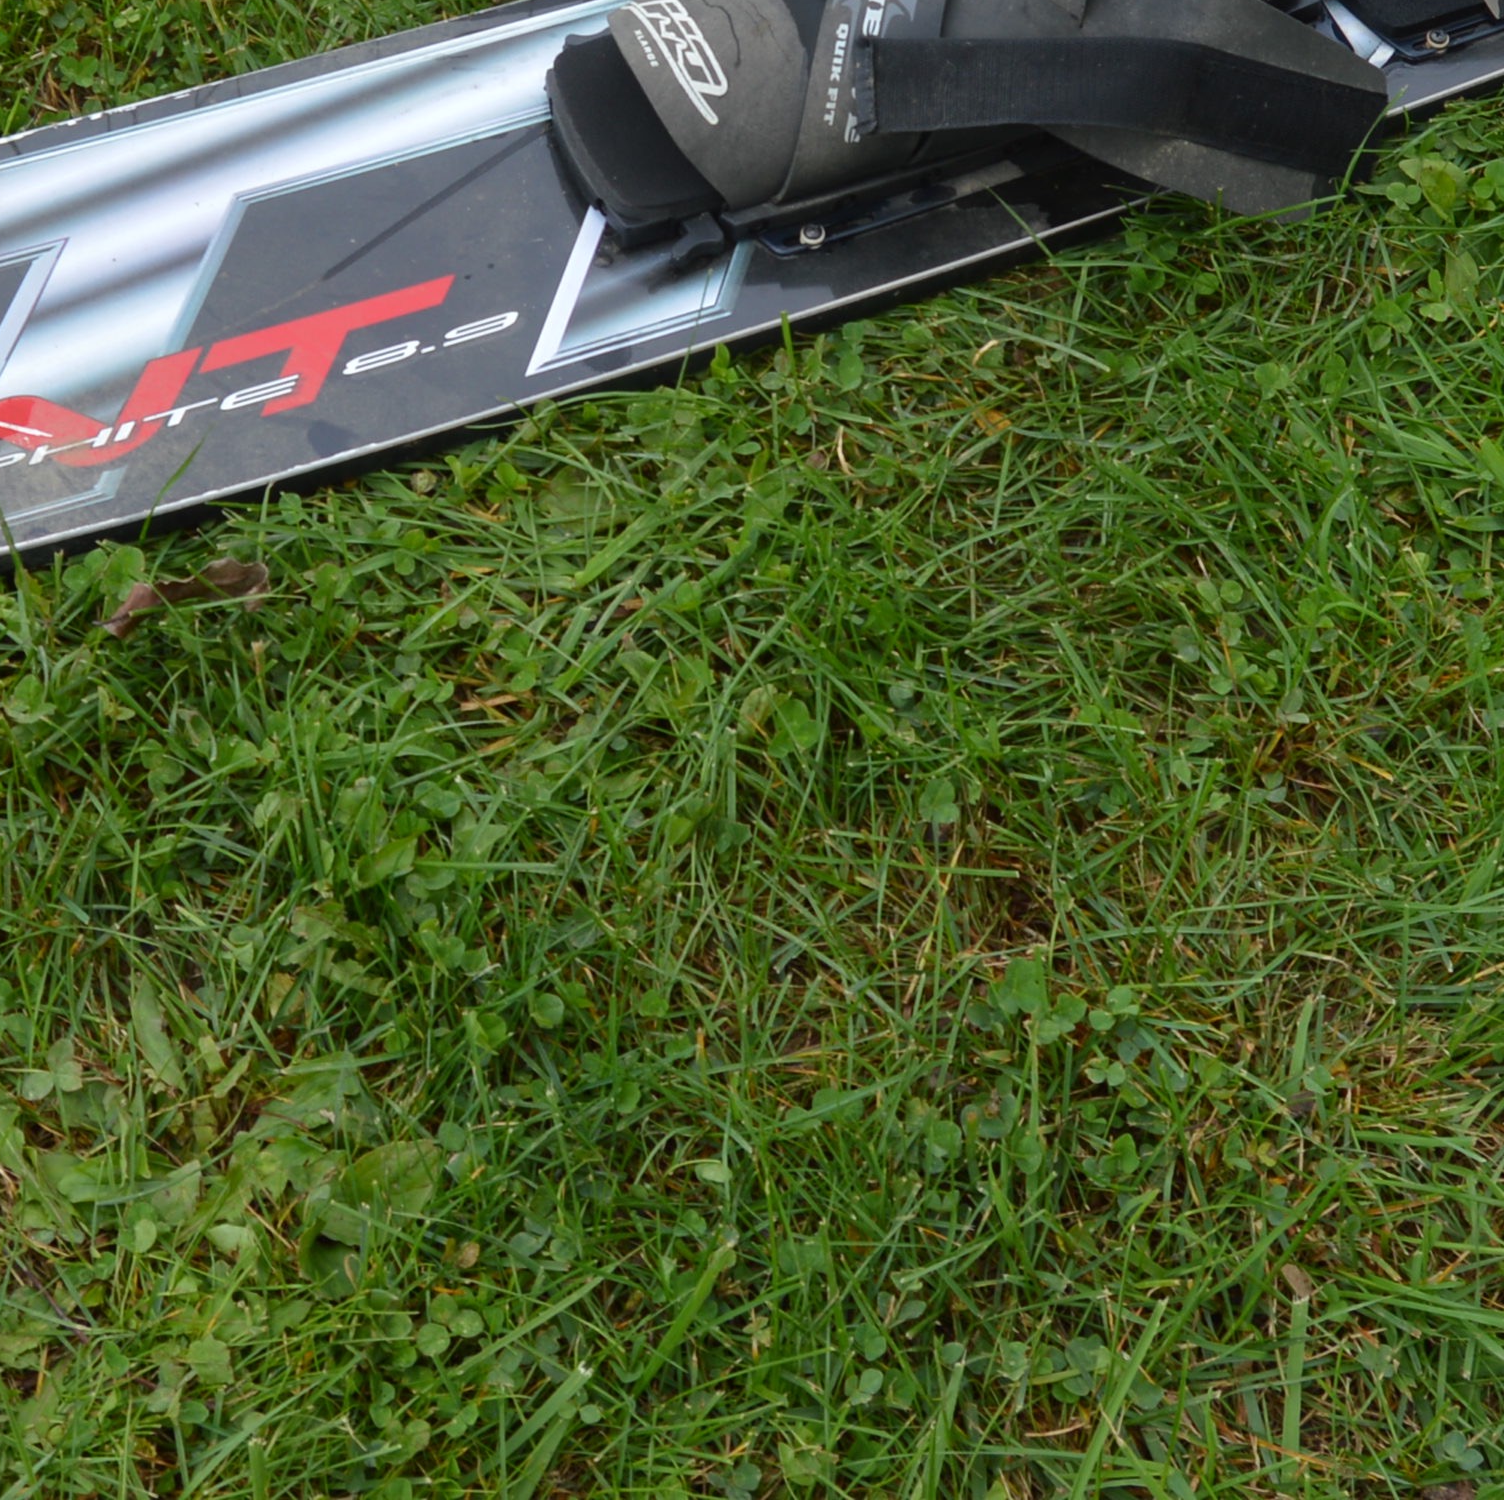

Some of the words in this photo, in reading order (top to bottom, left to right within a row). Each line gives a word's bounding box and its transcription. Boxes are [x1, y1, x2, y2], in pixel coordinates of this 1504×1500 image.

[830, 23, 849, 82] QUIK
[824, 87, 839, 126] FIT
[342, 309, 521, 376] 8.9
